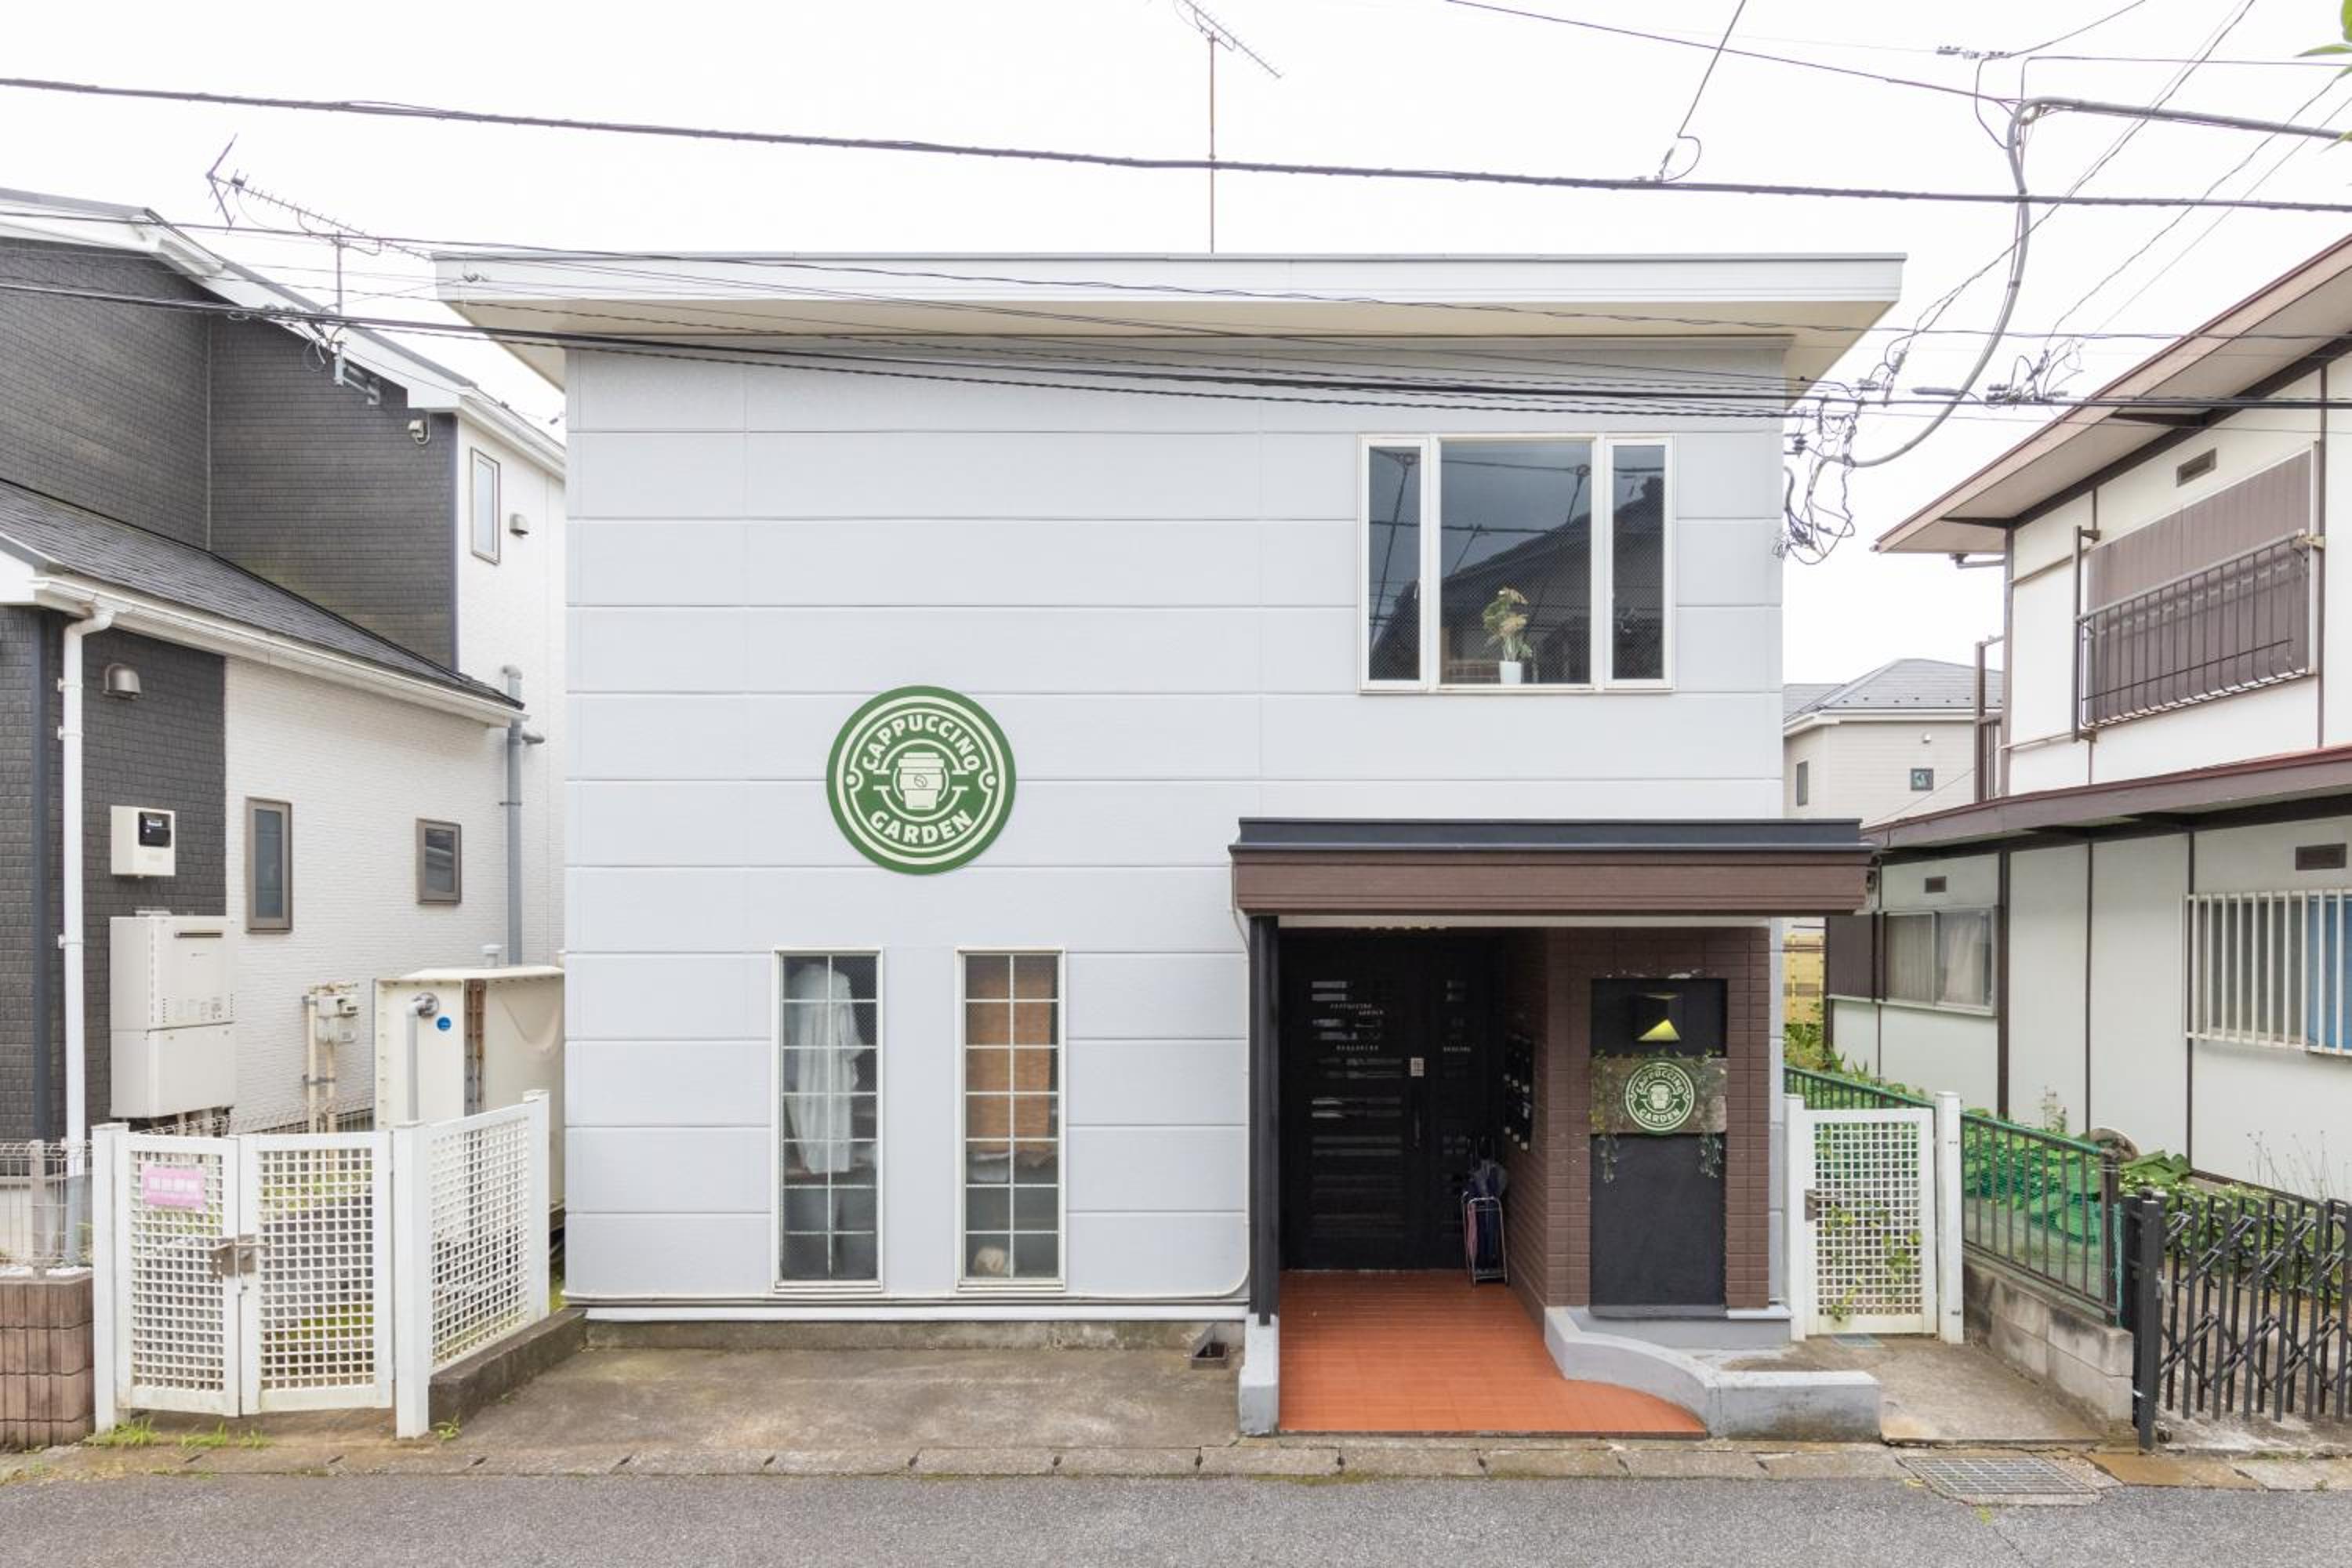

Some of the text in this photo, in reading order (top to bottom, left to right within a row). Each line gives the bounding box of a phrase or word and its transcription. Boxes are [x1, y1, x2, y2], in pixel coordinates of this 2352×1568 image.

[862, 714, 981, 771] CAPPUCCINO
[869, 810, 973, 844] GARDEN
[1635, 1069, 1684, 1094] CAPPUCCINO
[1639, 1108, 1680, 1123] GARDEN
